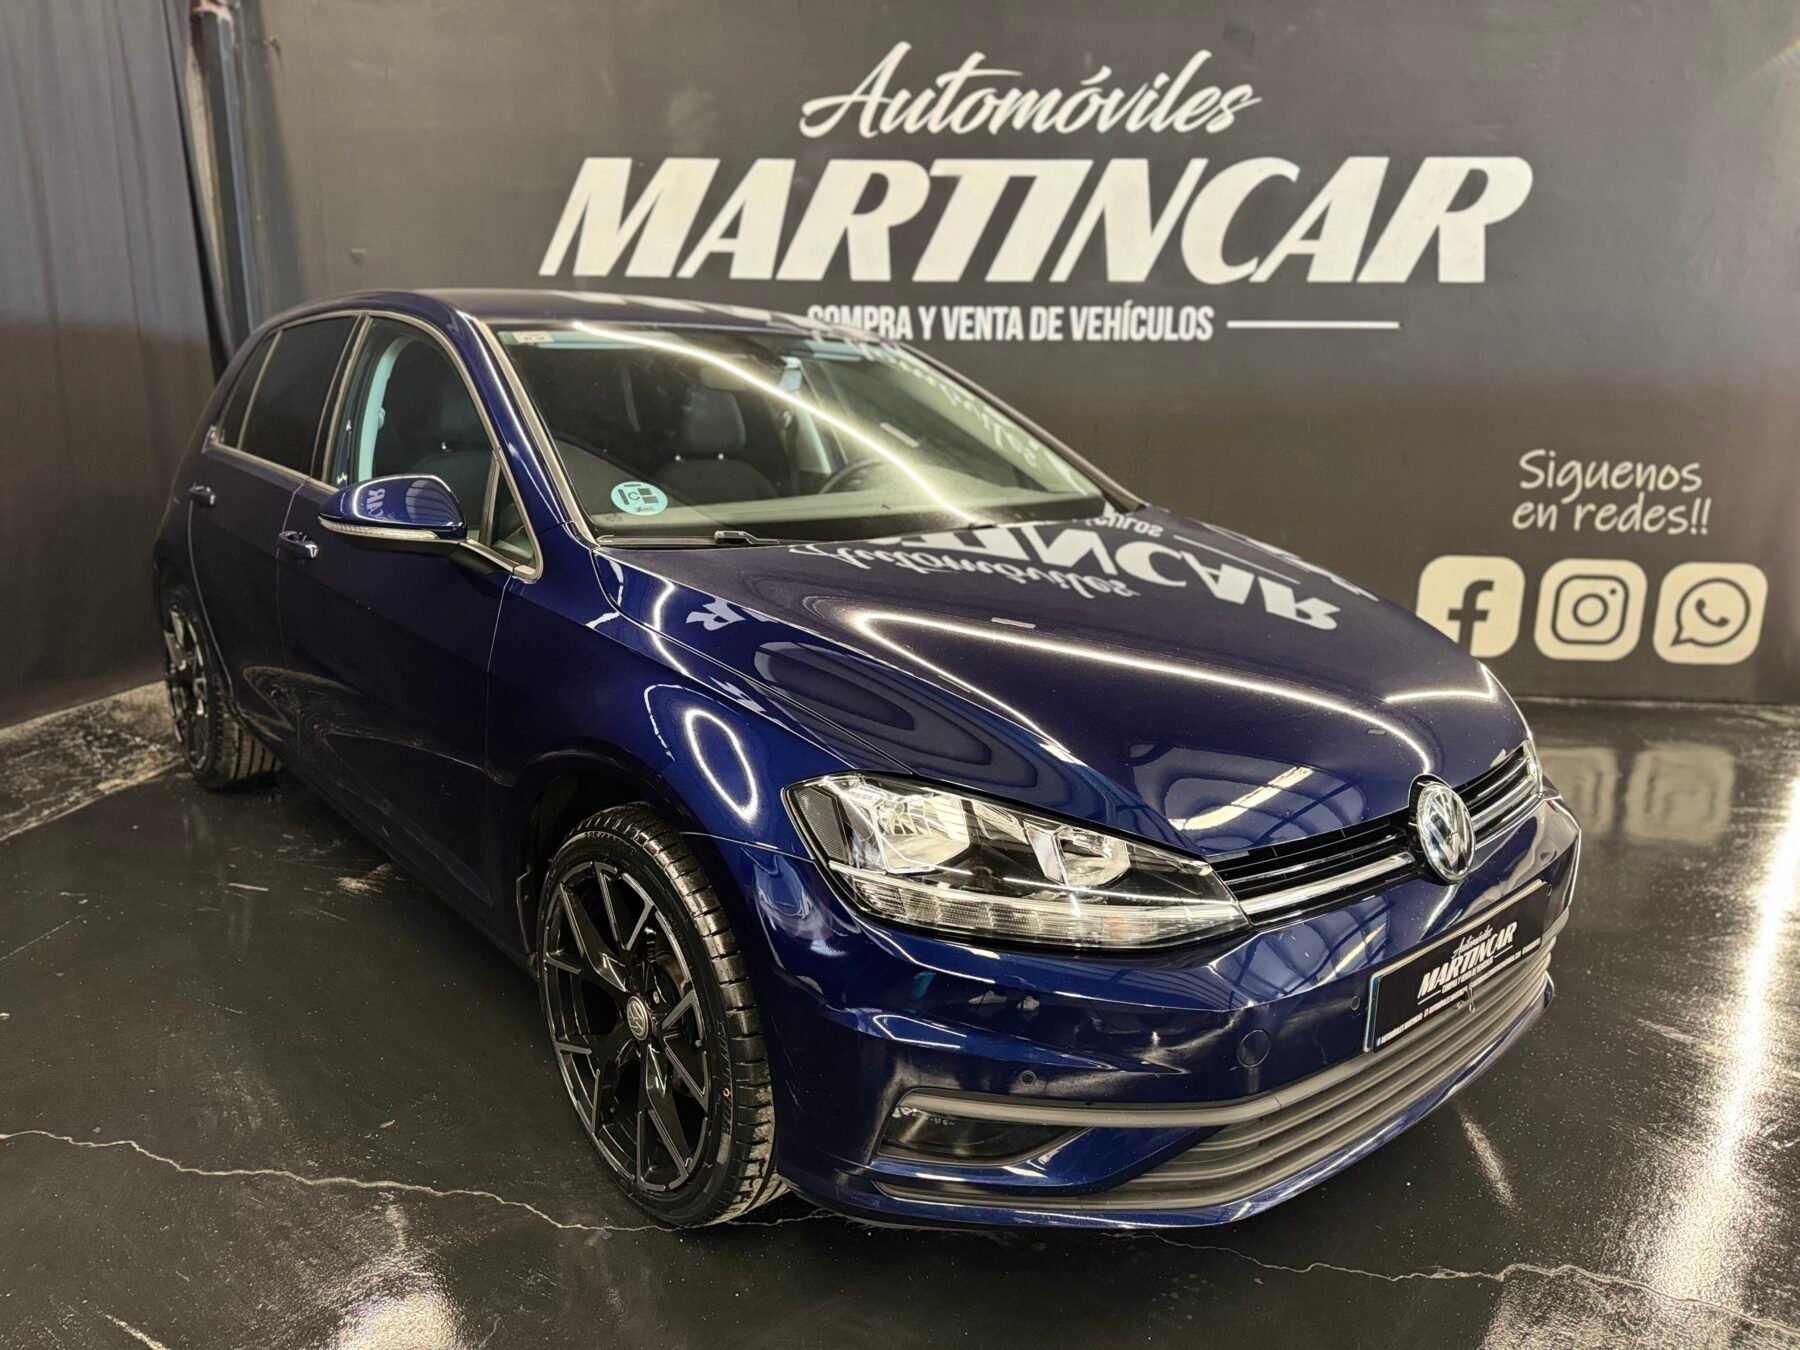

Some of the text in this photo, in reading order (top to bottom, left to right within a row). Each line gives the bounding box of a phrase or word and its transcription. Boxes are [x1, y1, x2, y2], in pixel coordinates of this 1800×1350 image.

[799, 40, 1262, 138] Automóviles
[538, 156, 1534, 285] MARTINCAR
[917, 305, 938, 341] Y
[940, 305, 1025, 341] VENTA
[1028, 305, 1066, 341] DE
[1069, 299, 1216, 341] VEHÍCULOS
[1518, 448, 1704, 504] Siguenos
[1511, 491, 1713, 536] en redes!!
[1416, 921, 1518, 1000] MARTINCAR
